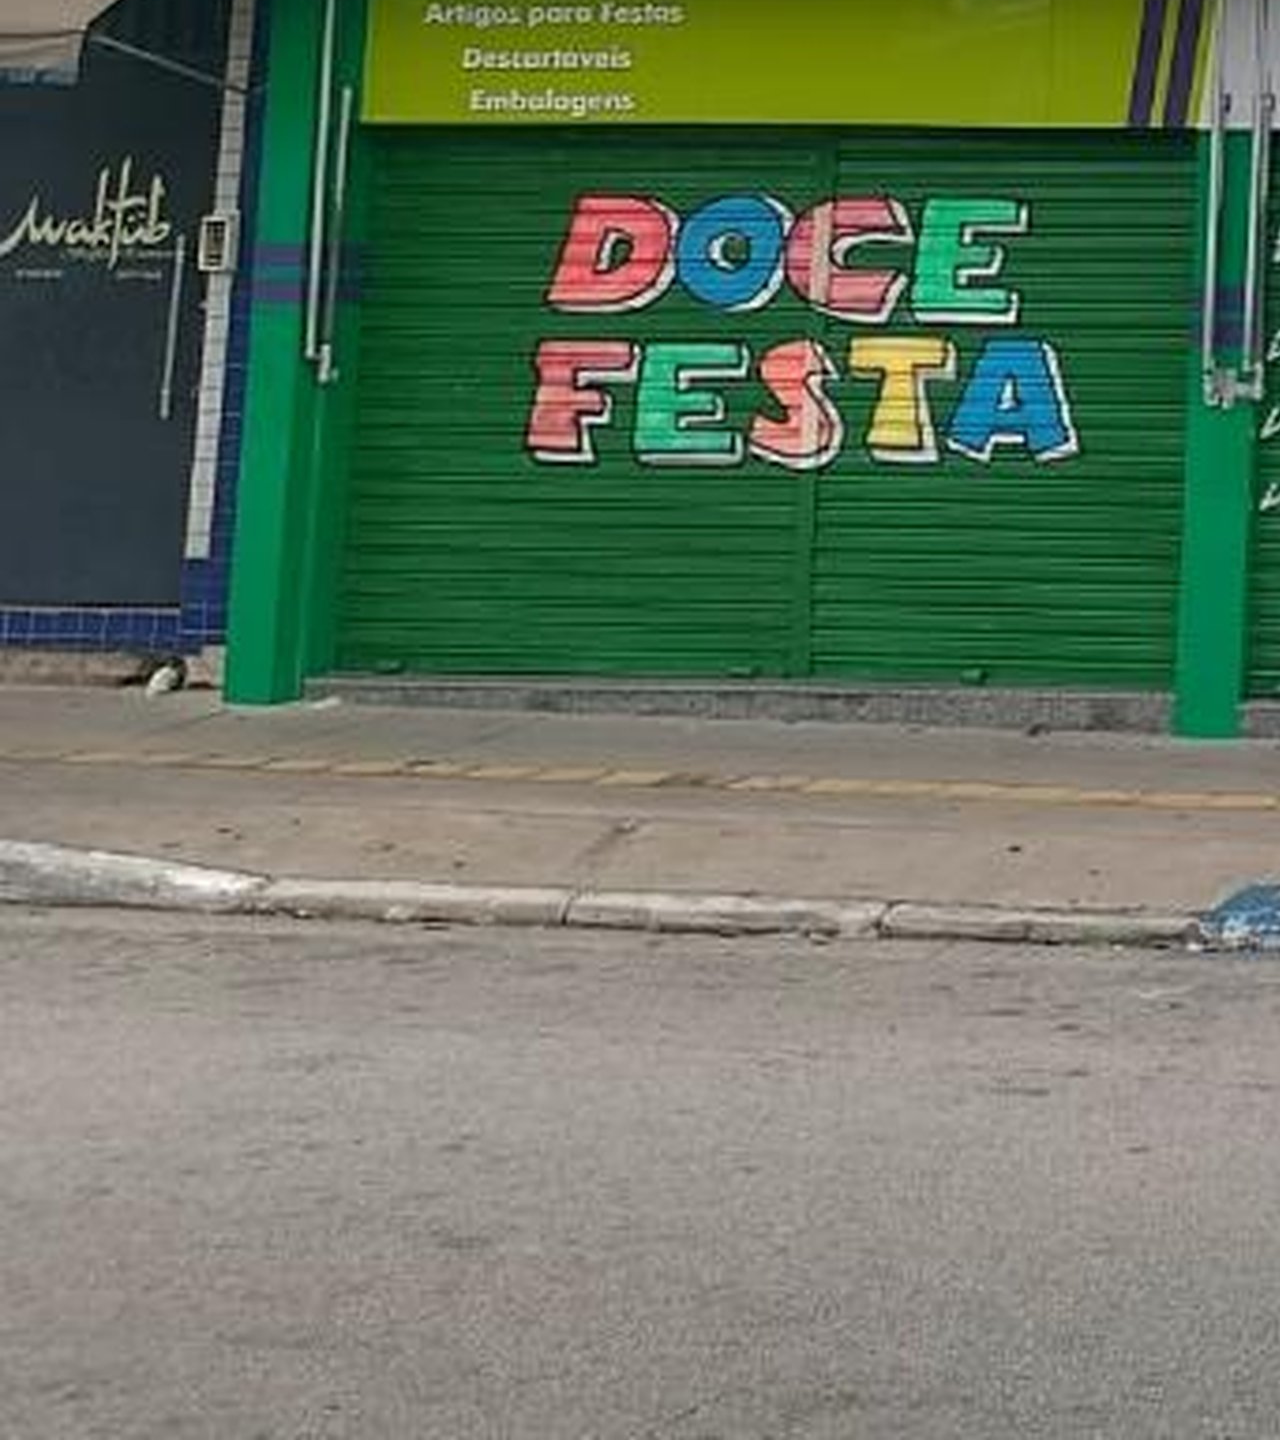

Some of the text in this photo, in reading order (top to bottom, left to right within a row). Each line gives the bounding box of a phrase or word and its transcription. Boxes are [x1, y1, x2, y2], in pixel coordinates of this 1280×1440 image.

[423, 2, 685, 28] Artigos para Festas
[470, 88, 636, 116] Embalagens
[545, 192, 1029, 325] DOCE
[524, 335, 1080, 472] FESTA
